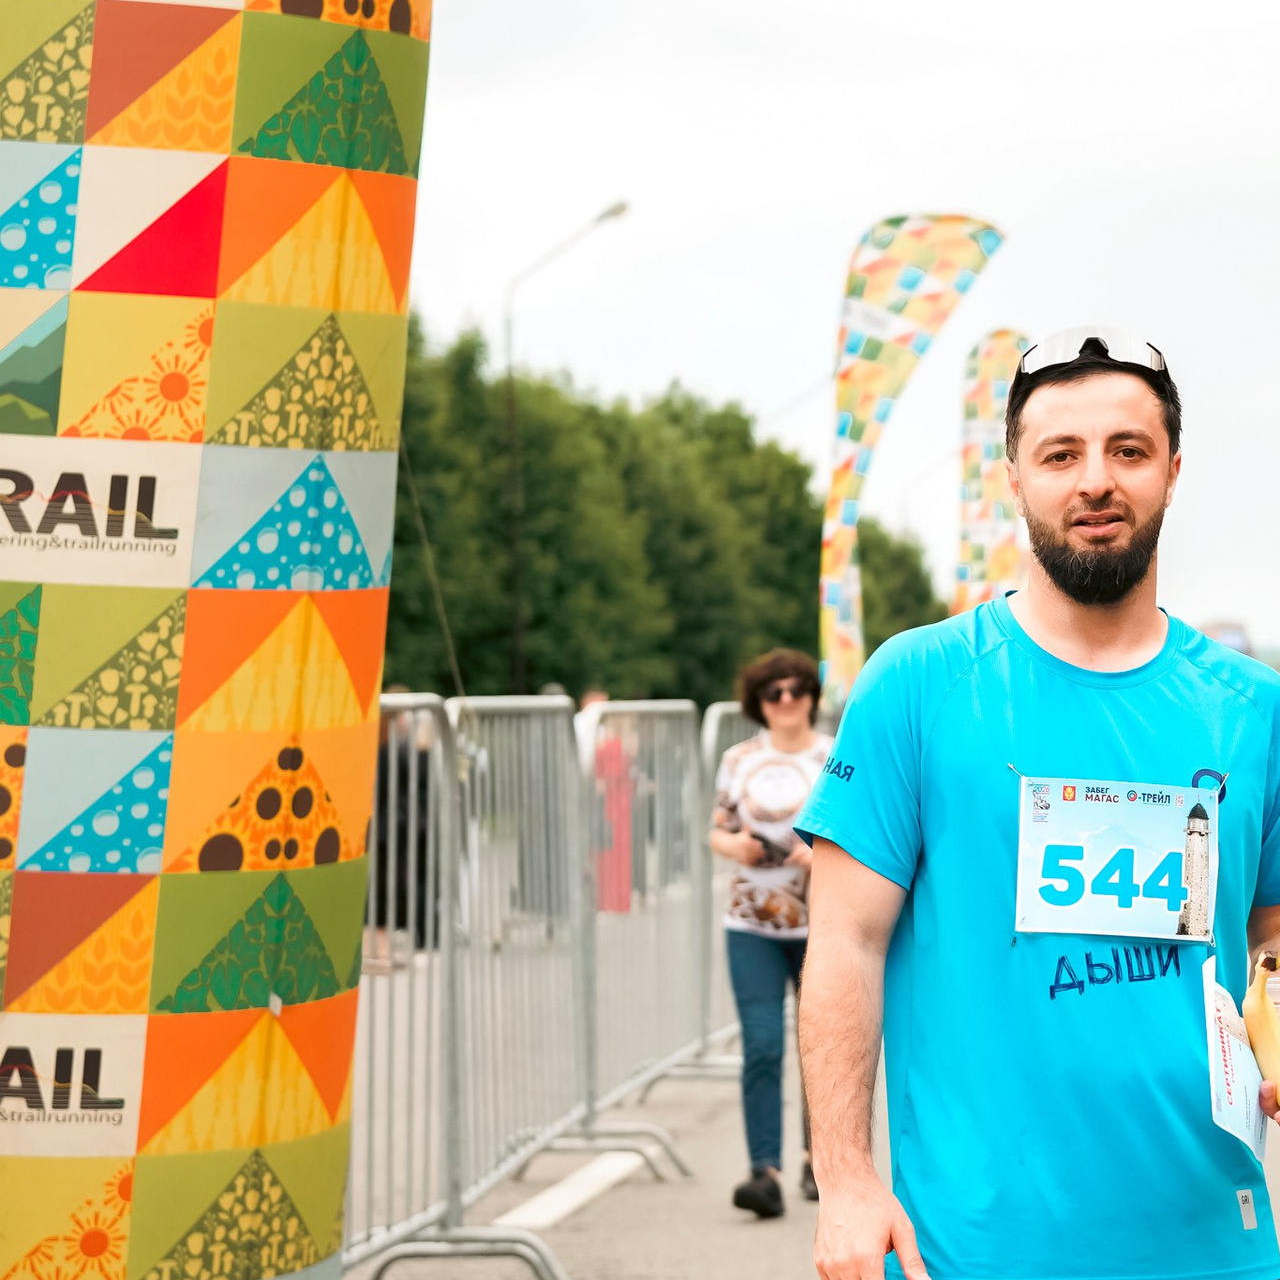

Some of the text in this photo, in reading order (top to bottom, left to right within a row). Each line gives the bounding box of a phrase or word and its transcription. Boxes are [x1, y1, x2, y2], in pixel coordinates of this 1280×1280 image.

[1085, 786, 1110, 794] ЗАБЕГ
[1085, 793, 1119, 803] МАГАС
[1038, 844, 1188, 912] 544
[1049, 943, 1181, 1000] ДЫШИ
